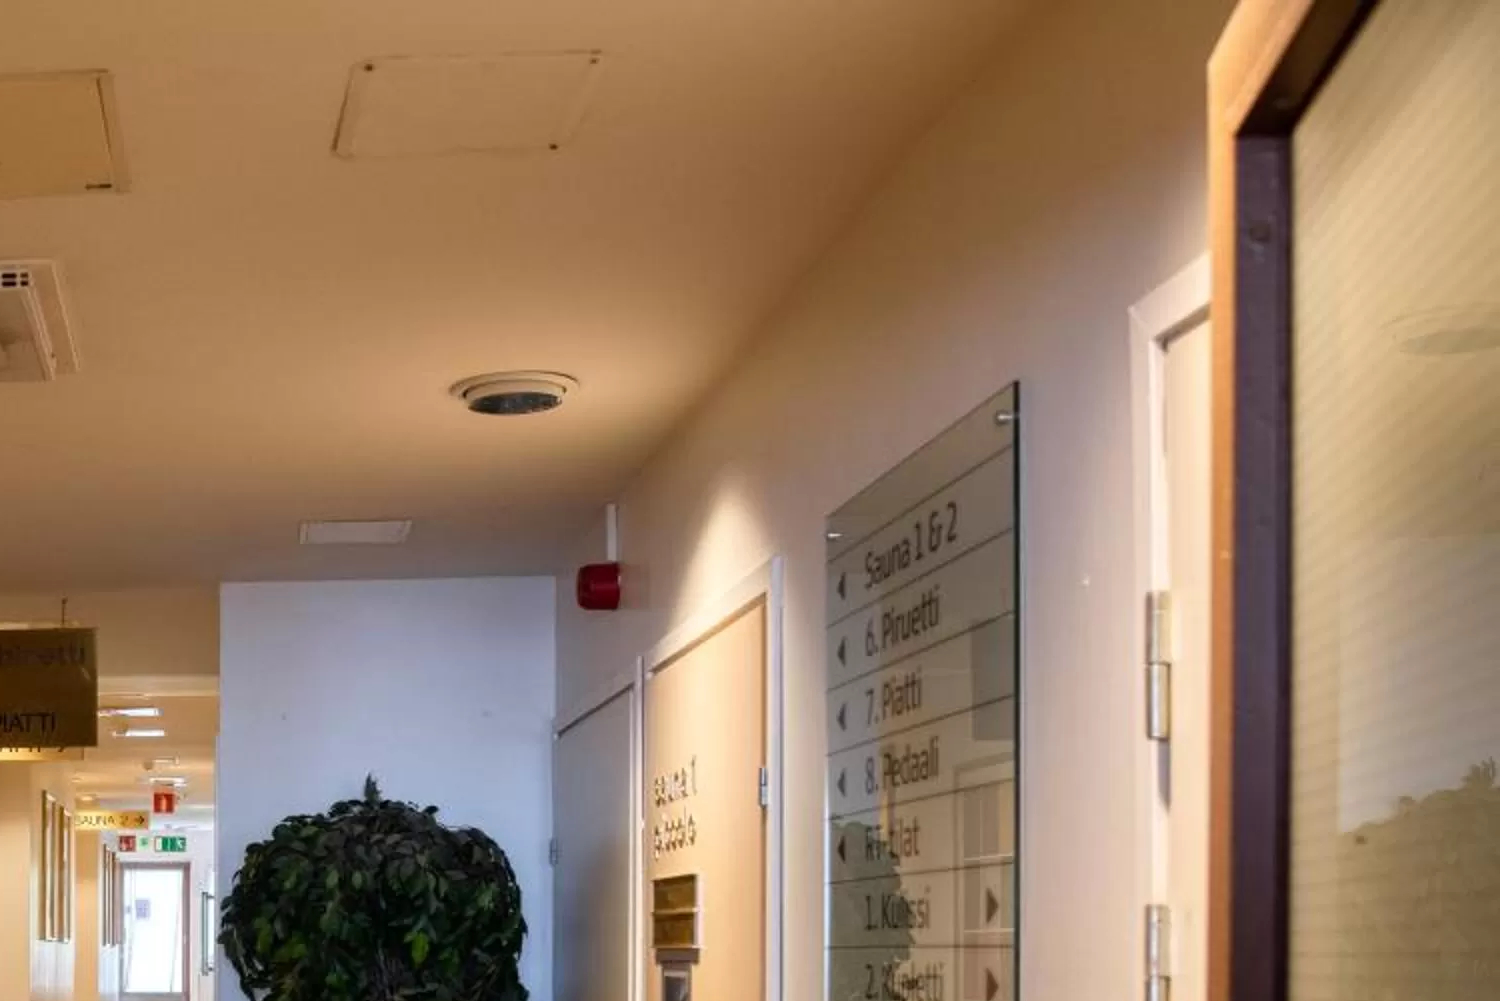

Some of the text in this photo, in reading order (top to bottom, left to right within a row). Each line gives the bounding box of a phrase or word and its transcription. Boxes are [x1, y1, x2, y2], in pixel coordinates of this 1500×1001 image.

[865, 537, 910, 590] Sauna
[913, 519, 923, 562] 1
[945, 500, 958, 544] 2
[881, 584, 940, 653] Piruetti
[882, 666, 922, 720] Piatti
[881, 735, 940, 790] Pedaali
